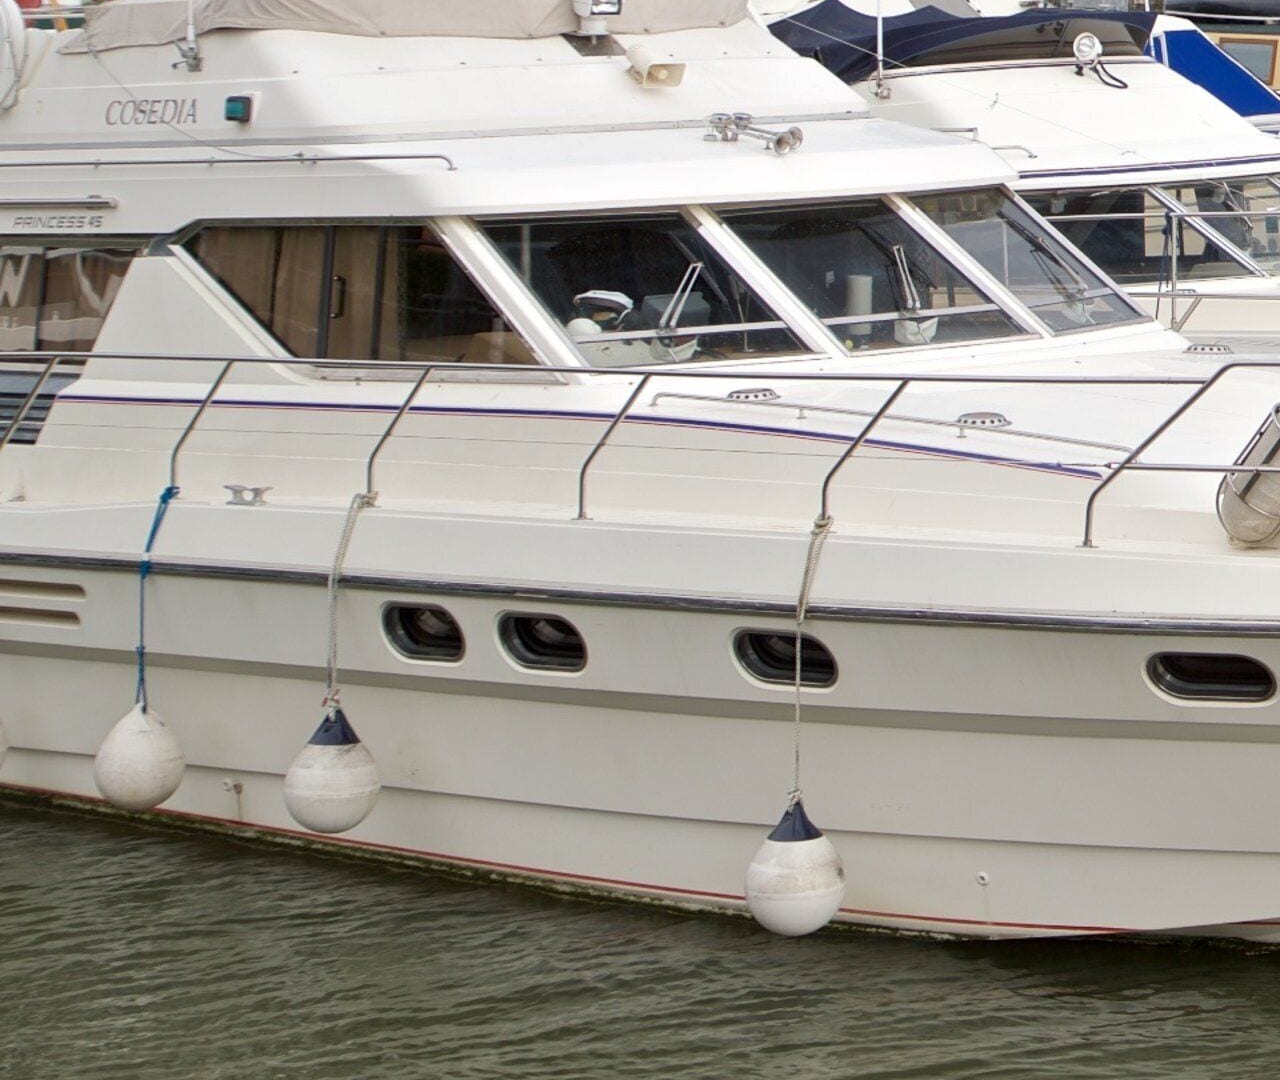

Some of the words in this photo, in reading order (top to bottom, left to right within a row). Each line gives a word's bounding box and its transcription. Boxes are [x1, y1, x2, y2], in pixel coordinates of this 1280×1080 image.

[105, 98, 197, 126] COSEDIA
[13, 216, 86, 229] PRINCESS
[88, 215, 104, 228] 45
